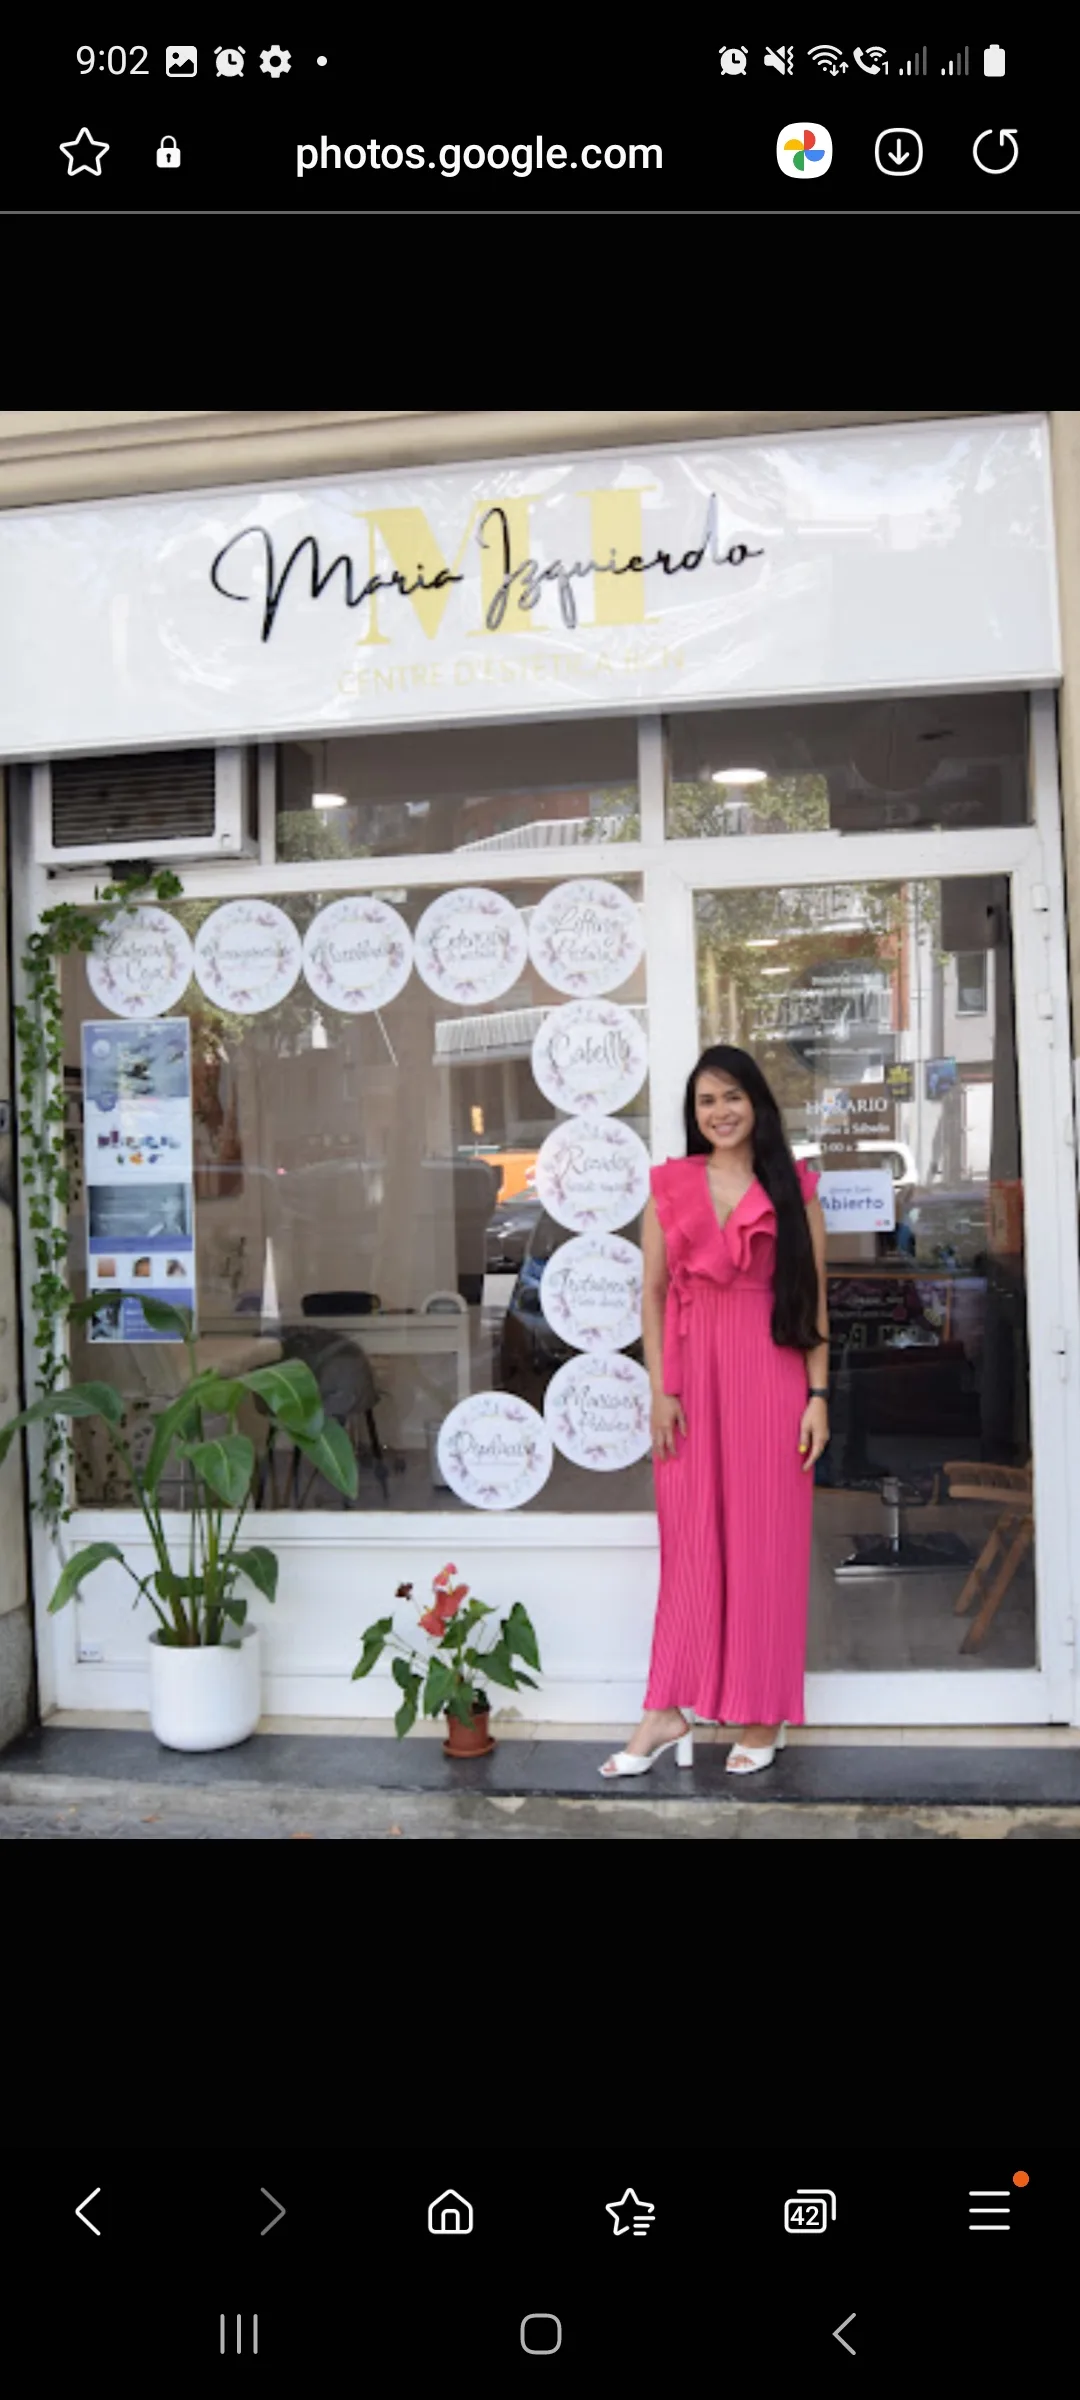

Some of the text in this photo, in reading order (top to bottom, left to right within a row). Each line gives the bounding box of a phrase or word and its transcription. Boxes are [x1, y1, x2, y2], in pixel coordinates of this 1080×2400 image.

[211, 525, 463, 643] Maria
[336, 662, 443, 696] CENTRE
[805, 1095, 888, 1116] HORARIO
[820, 1195, 885, 1211] Abierto
